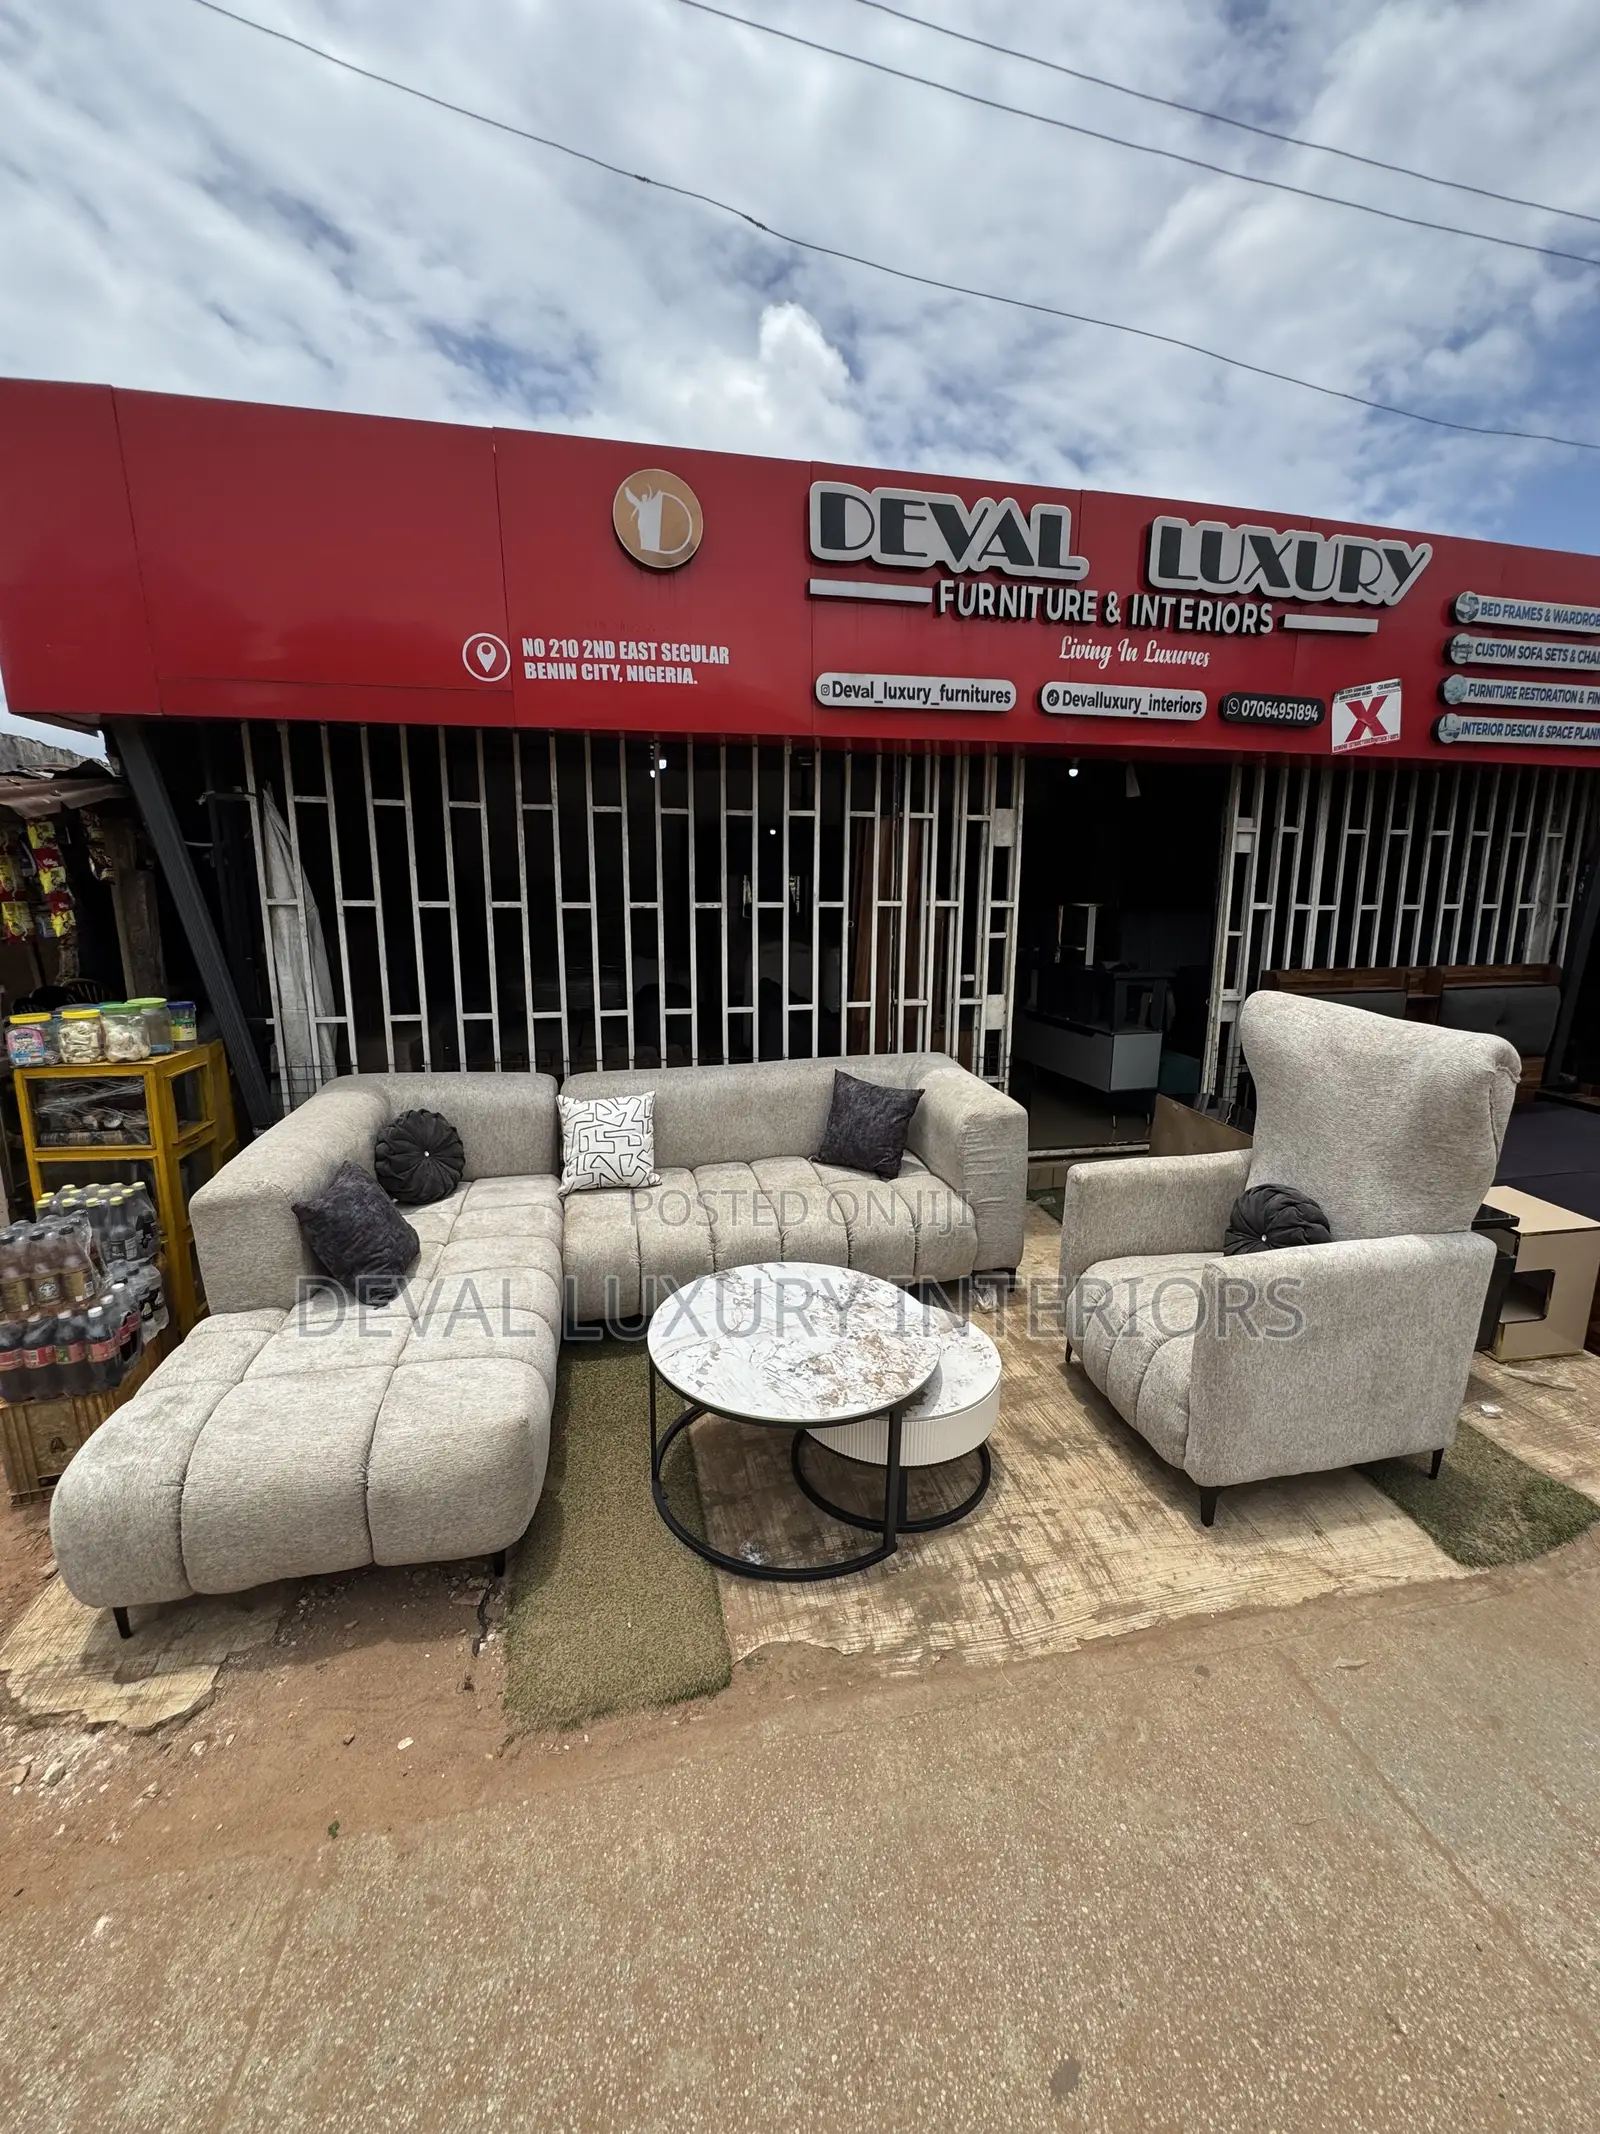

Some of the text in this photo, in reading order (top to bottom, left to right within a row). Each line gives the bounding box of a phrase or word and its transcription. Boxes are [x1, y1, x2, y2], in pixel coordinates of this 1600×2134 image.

[817, 489, 1428, 599] DEVAL LUXURY
[940, 579, 1274, 634] FURNITURE & INTERIORS
[1480, 602, 1501, 617] BED
[1502, 604, 1543, 621] FRAMES
[1544, 608, 1551, 622] &
[522, 638, 730, 664] NO 210 2ND EAST SECULAR
[1059, 635, 1211, 669] Living In Luxuries
[1475, 642, 1516, 659] CUSTOM
[1518, 645, 1543, 661] SOFA
[1544, 647, 1569, 662] SETS
[1570, 649, 1576, 663] &
[524, 661, 698, 685] BENIN CITY, NIGERIA.
[831, 680, 1012, 706] Deval_luxury_furnitures
[1062, 689, 1203, 716] Devalluxury_interiors
[1468, 683, 1518, 700] FURNITURE
[1518, 686, 1578, 704] RESTORATION
[1578, 690, 1585, 704] &
[1241, 699, 1319, 722] 07064951894
[1461, 721, 1503, 736] INTERIOR
[1504, 723, 1538, 738] DESIGN
[1538, 725, 1544, 738] &
[1545, 725, 1574, 739] SPACE
